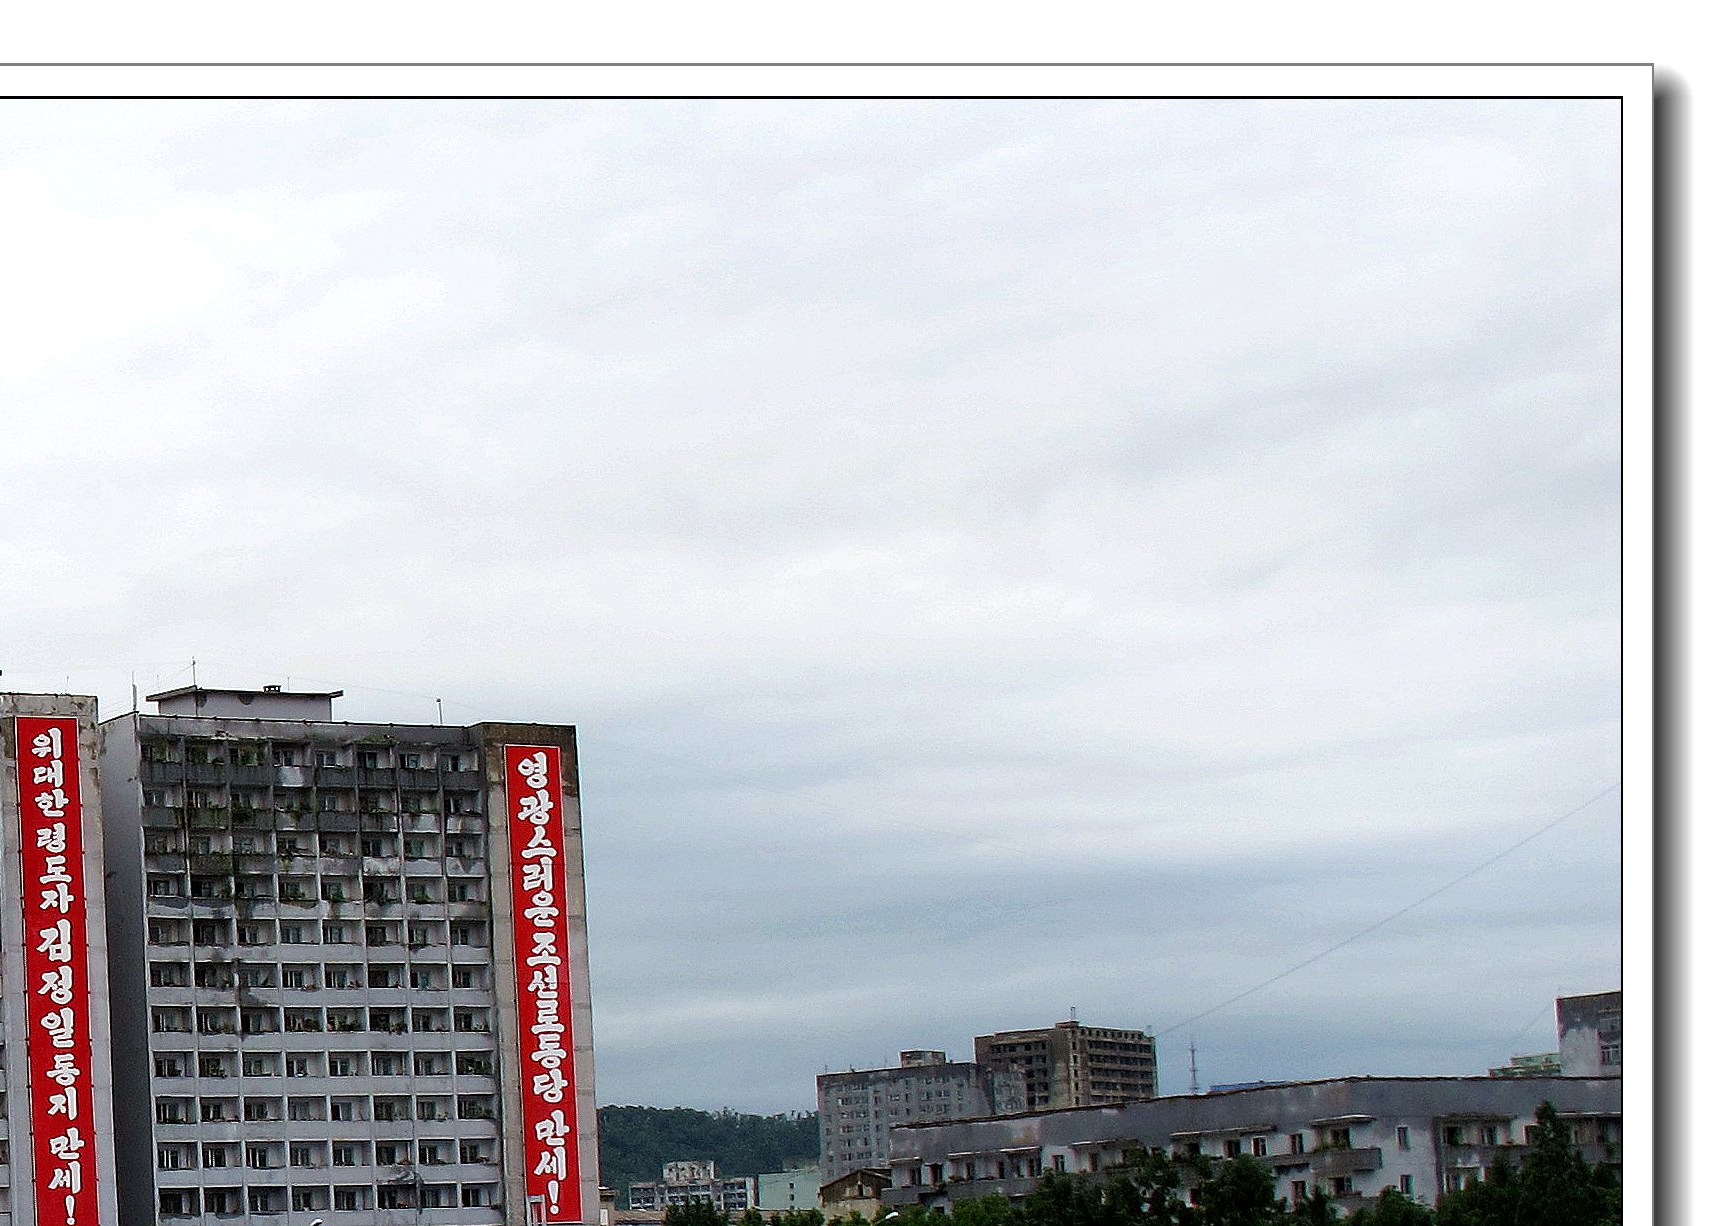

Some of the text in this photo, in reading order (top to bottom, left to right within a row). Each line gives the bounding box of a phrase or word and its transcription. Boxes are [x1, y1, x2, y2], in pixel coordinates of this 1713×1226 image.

[31, 727, 85, 1226] 위대한 령도자 김정일 동지 만세!
[517, 751, 570, 1215] 영광스러운 조선로동당 만세!
